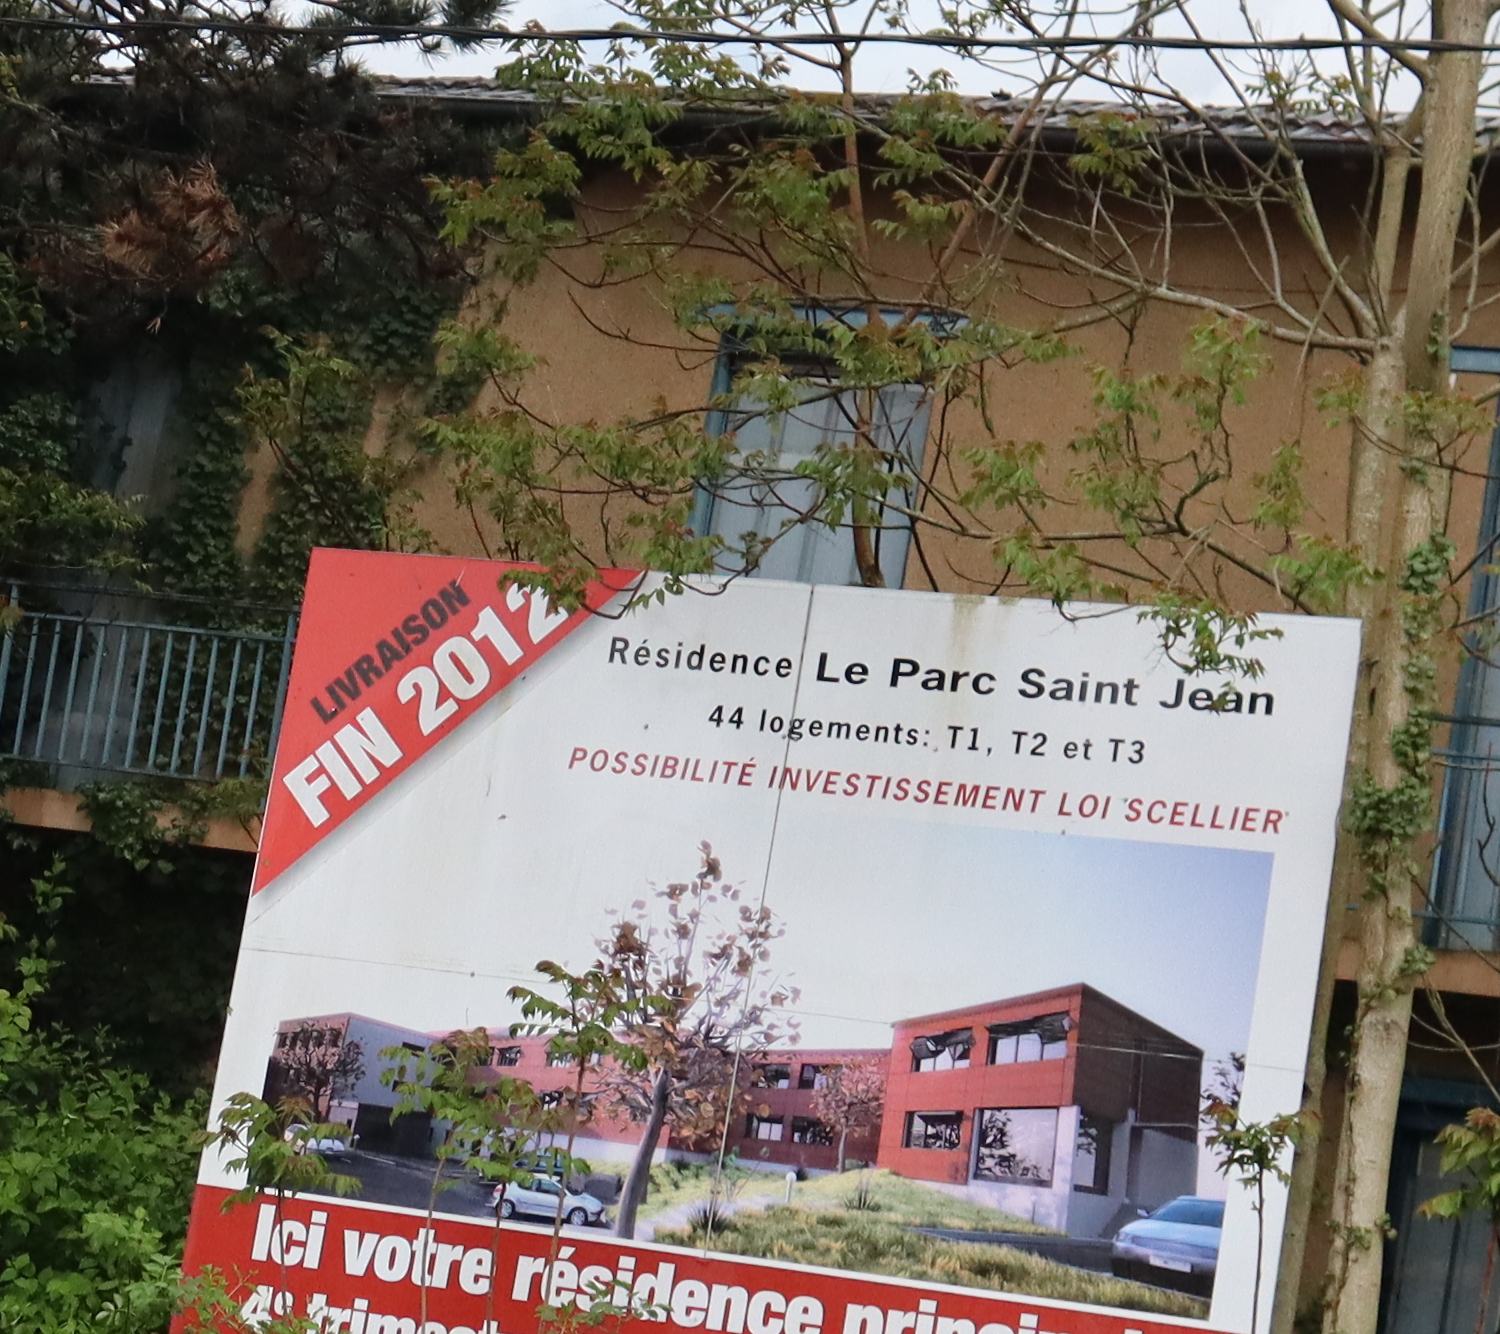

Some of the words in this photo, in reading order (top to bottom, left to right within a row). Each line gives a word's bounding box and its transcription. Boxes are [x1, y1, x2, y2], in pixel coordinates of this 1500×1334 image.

[310, 580, 471, 725] LIVRAISON
[608, 636, 793, 678] Résidence
[816, 652, 869, 685] Le
[889, 657, 997, 696] Parc
[1018, 667, 1140, 707] Saint
[1158, 678, 1275, 716] Jean
[282, 707, 404, 828] FIN
[396, 581, 570, 737] 2012
[708, 705, 745, 731] 44
[759, 709, 930, 747] logements:
[947, 725, 994, 757] T1,
[1012, 730, 1048, 758] T2
[1063, 738, 1093, 761] et
[1108, 738, 1146, 764] T3
[568, 747, 757, 787] POSSIBILITÉ
[767, 766, 1046, 814] INVESTISSEMENT
[1057, 792, 1112, 820] LOI
[1124, 798, 1285, 835] SCELLIER
[250, 1203, 328, 1270] Ici
[343, 1227, 495, 1296] votre
